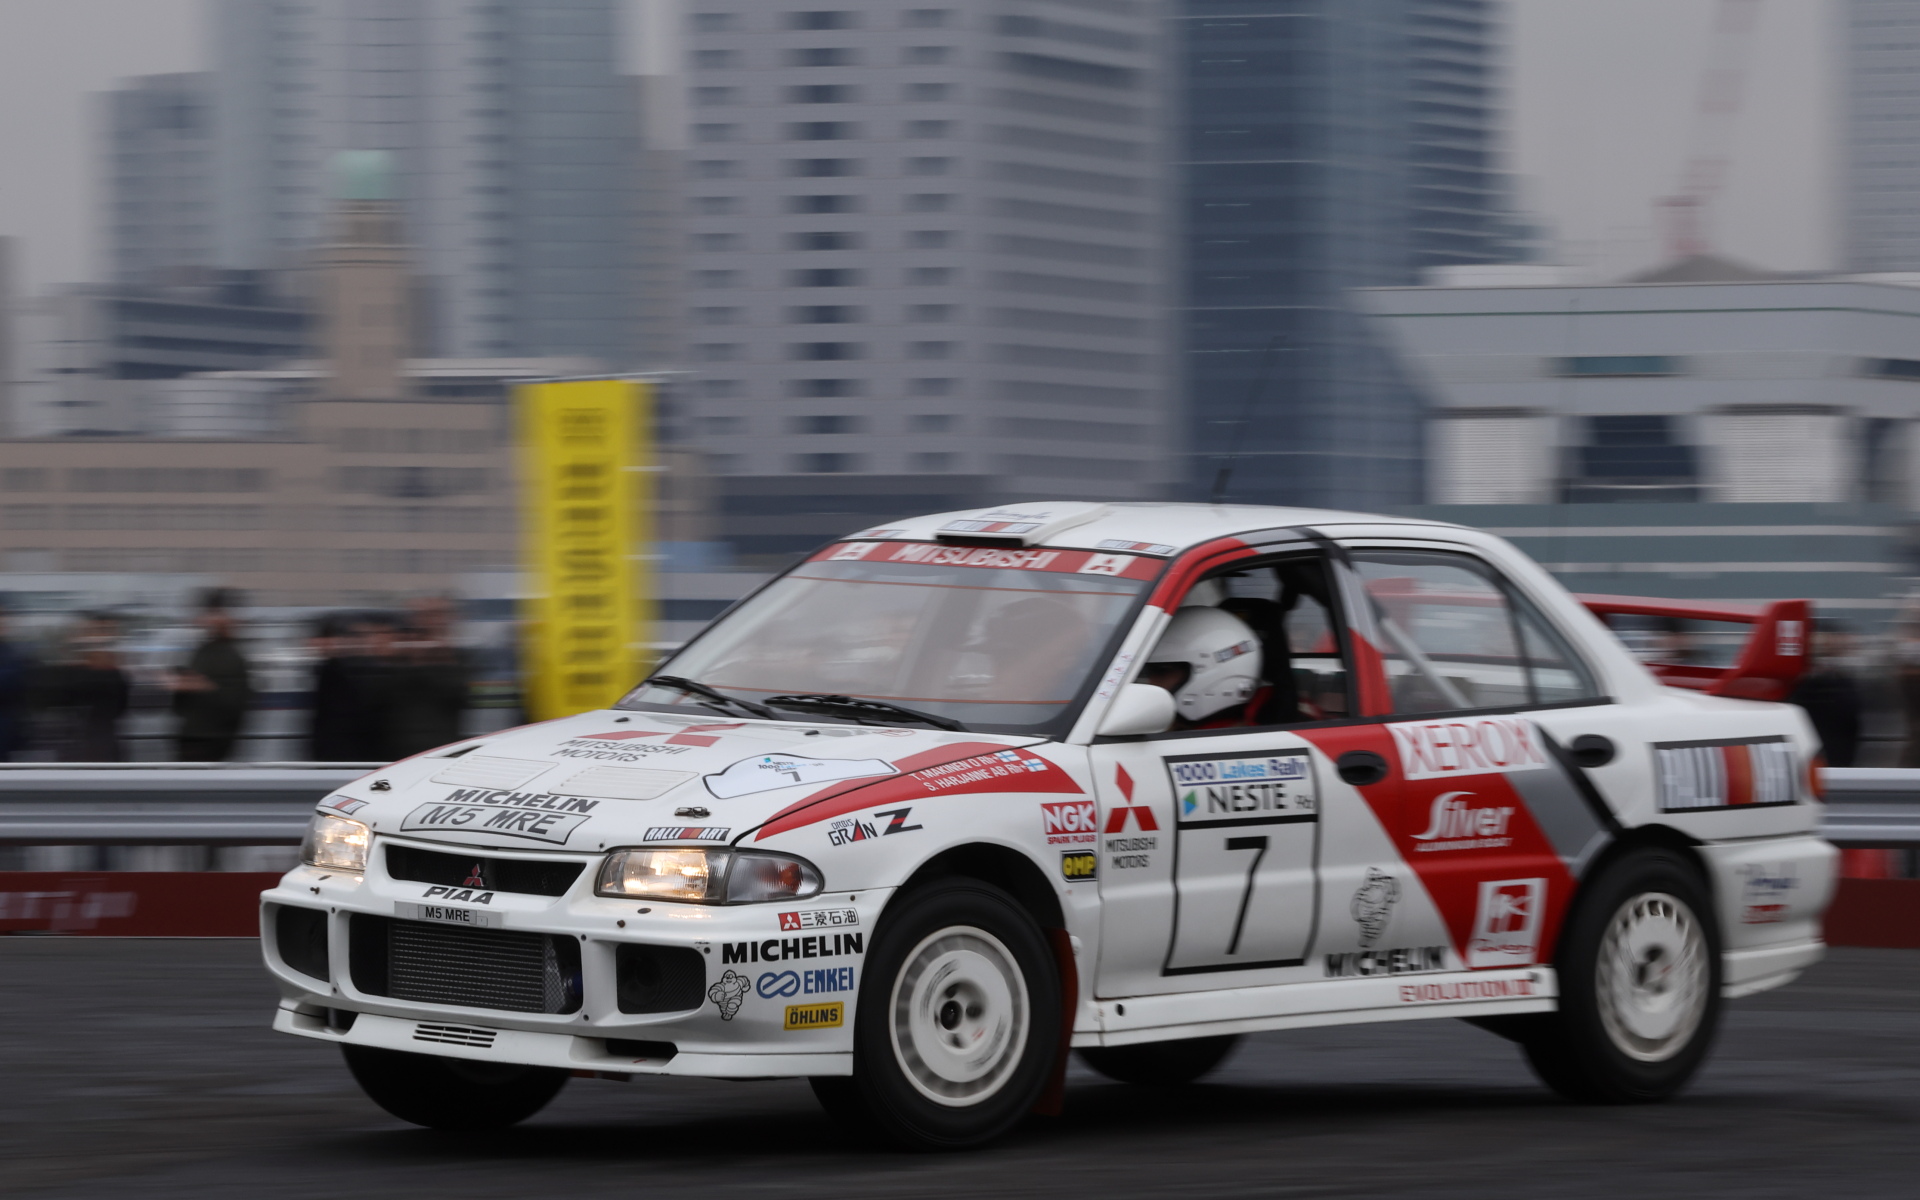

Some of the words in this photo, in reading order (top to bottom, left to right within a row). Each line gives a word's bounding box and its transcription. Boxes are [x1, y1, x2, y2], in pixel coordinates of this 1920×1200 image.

[889, 544, 1060, 569] MITSUBISHI
[549, 749, 647, 762] MOTORS
[557, 740, 691, 754] MITSUBISHI
[1394, 719, 1546, 773] XEROX
[781, 771, 801, 782] 7
[921, 760, 969, 779] MAKINEN
[935, 769, 994, 788] HARJANNE
[989, 765, 1006, 777] AB
[1174, 762, 1218, 781] 1000
[1218, 760, 1266, 779] Lakes
[1267, 758, 1308, 776] Rally
[444, 789, 600, 813] MICHELIN
[1206, 783, 1289, 813] NESTE
[419, 806, 485, 825] M5
[483, 809, 566, 835] MRE
[831, 818, 854, 830] ORBIS
[874, 807, 923, 836] Z
[1042, 803, 1096, 833] NGK
[1409, 790, 1516, 840] Silver
[645, 828, 685, 840] RALLI
[698, 828, 728, 840] ART
[1047, 836, 1070, 845] SPARK
[1072, 835, 1096, 843] PLUGS
[1105, 837, 1158, 852] MITSUBISHI
[1063, 856, 1096, 876] OMP
[1112, 855, 1149, 869] MOTORS
[422, 886, 494, 904] PIAA
[1225, 836, 1270, 955] 7
[425, 907, 442, 919] M5
[445, 909, 470, 922] MRE
[801, 909, 857, 926] 三菱石油
[722, 932, 863, 965] MICHELIN
[803, 967, 854, 994] ENKEI
[789, 1008, 838, 1025] ÖHLINS
